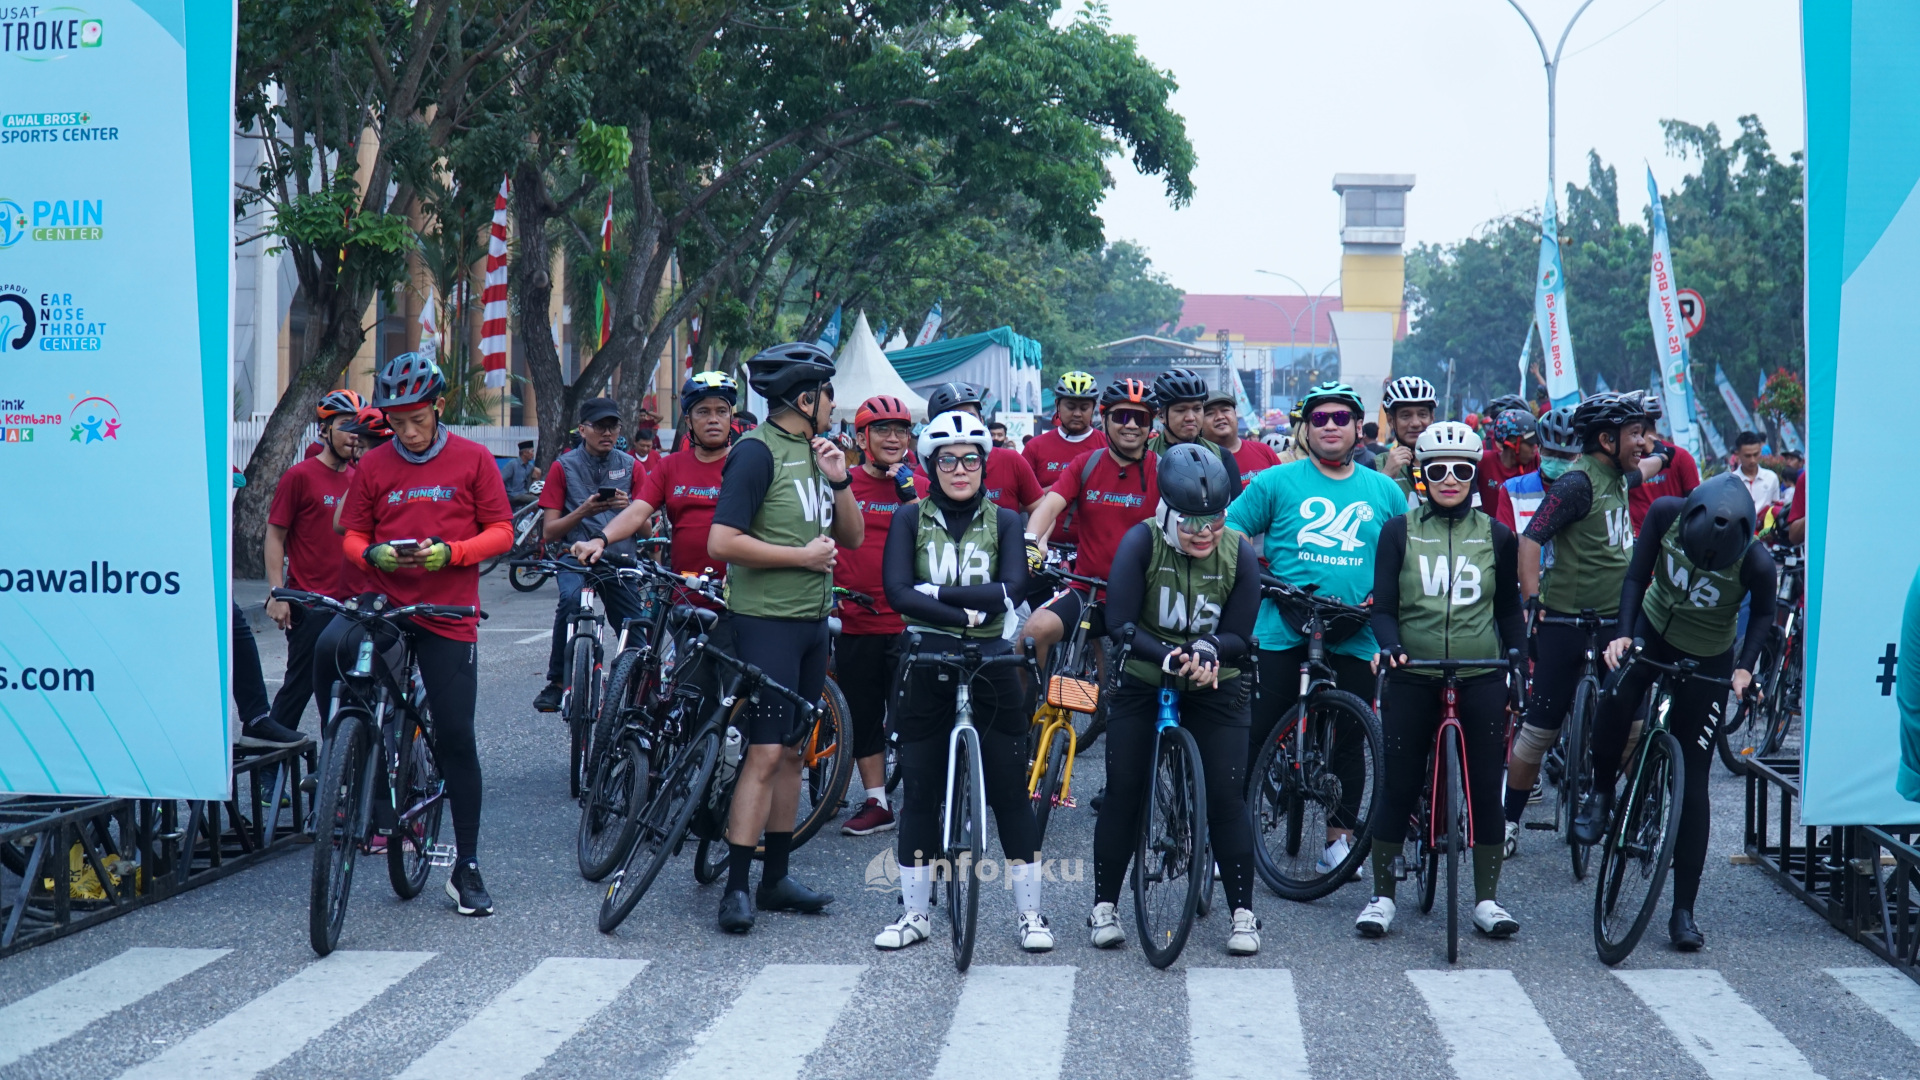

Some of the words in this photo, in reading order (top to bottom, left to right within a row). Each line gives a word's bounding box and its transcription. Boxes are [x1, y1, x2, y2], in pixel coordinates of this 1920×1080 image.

[0, 6, 39, 20] USAT
[3, 20, 78, 51] TROKE
[7, 114, 40, 126] AWAL
[44, 113, 76, 125] BROS
[1, 129, 58, 143] SPORTS
[62, 127, 119, 141] CENTER
[33, 200, 102, 226] PAIN
[35, 227, 100, 239] CENTER
[41, 293, 72, 306] EAR
[1546, 294, 1554, 309] RS
[40, 308, 84, 321] NOSE
[40, 323, 107, 336] THROAT
[1549, 312, 1558, 342] AWAL
[43, 338, 98, 350] CENTER
[1552, 345, 1563, 377] BROS
[1297, 497, 1374, 551] 24
[1419, 555, 1481, 605] WB
[1697, 701, 1721, 750] MAAP
